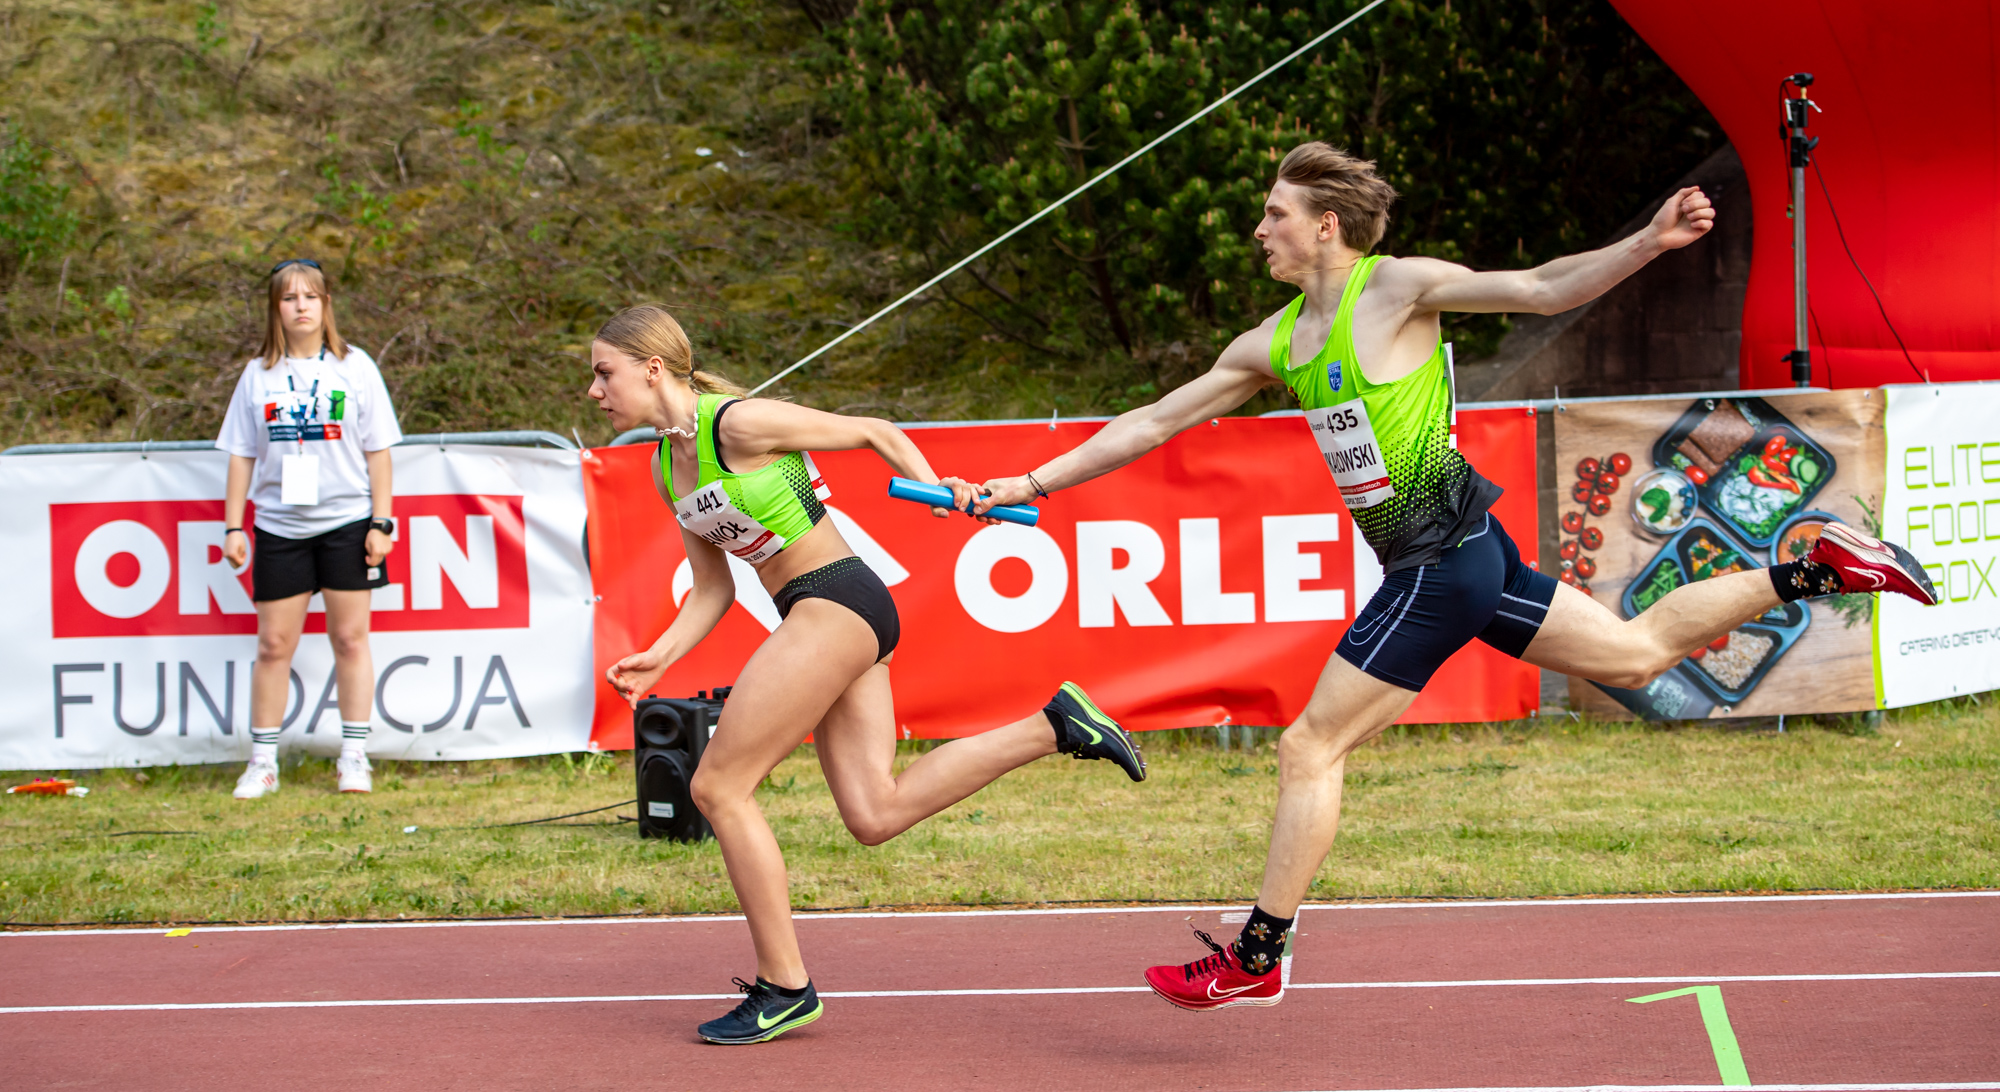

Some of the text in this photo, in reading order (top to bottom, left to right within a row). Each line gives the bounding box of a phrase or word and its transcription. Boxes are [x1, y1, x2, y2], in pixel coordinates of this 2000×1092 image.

[1327, 408, 1358, 434] 435
[1904, 442, 2000, 490] ELITE
[697, 490, 723, 514] 441
[1907, 499, 2000, 550] FOOD
[74, 515, 499, 619] ORN
[1922, 556, 1998, 607] BOX
[1900, 636, 1950, 656] CATERING
